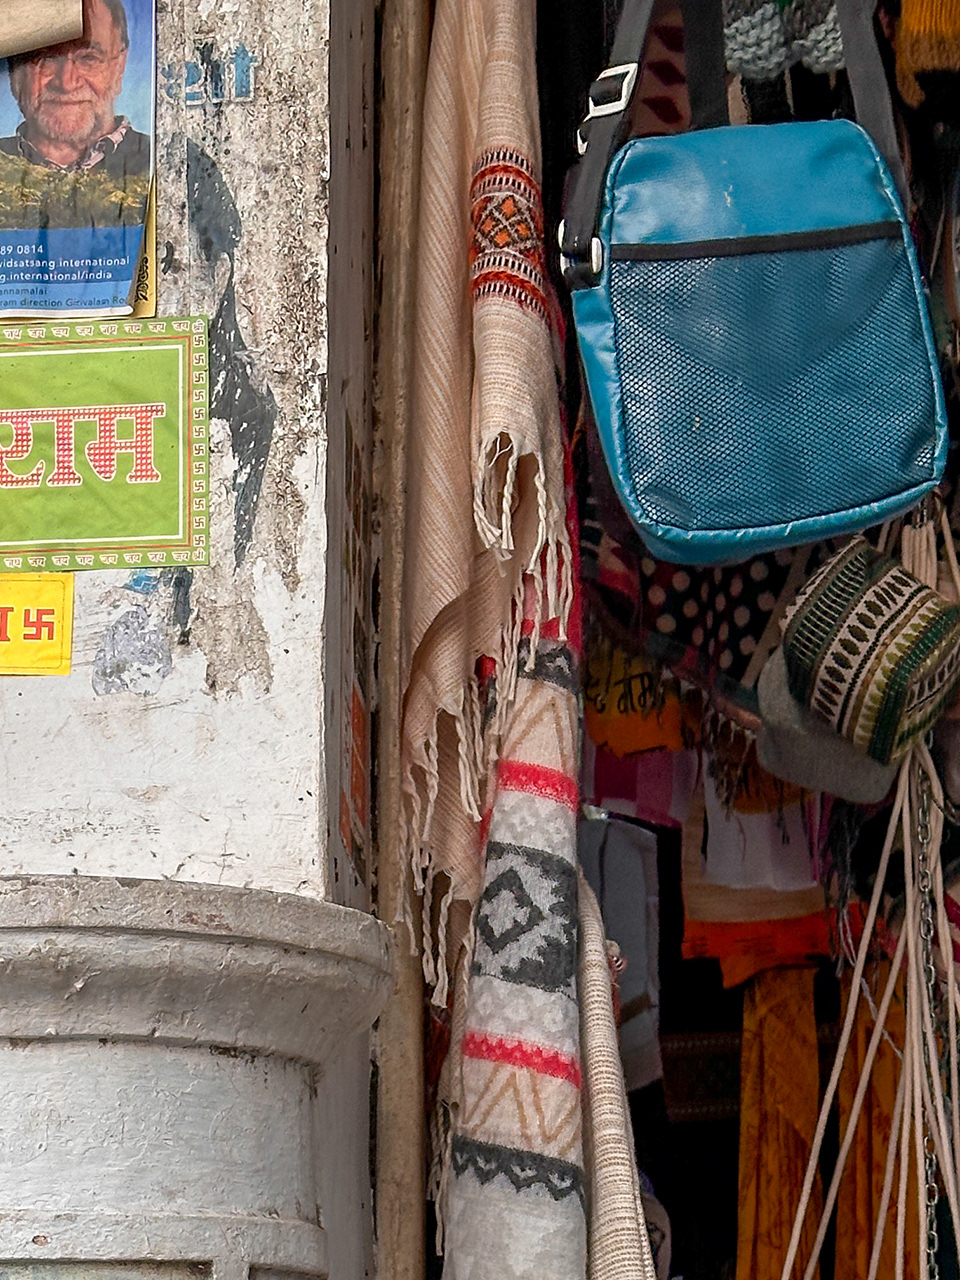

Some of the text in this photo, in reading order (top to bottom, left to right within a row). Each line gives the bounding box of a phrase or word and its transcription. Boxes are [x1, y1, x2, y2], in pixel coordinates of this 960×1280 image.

[17, 244, 44, 255] 0814
[20, 297, 62, 307] direction
[112, 295, 126, 305] Ro
